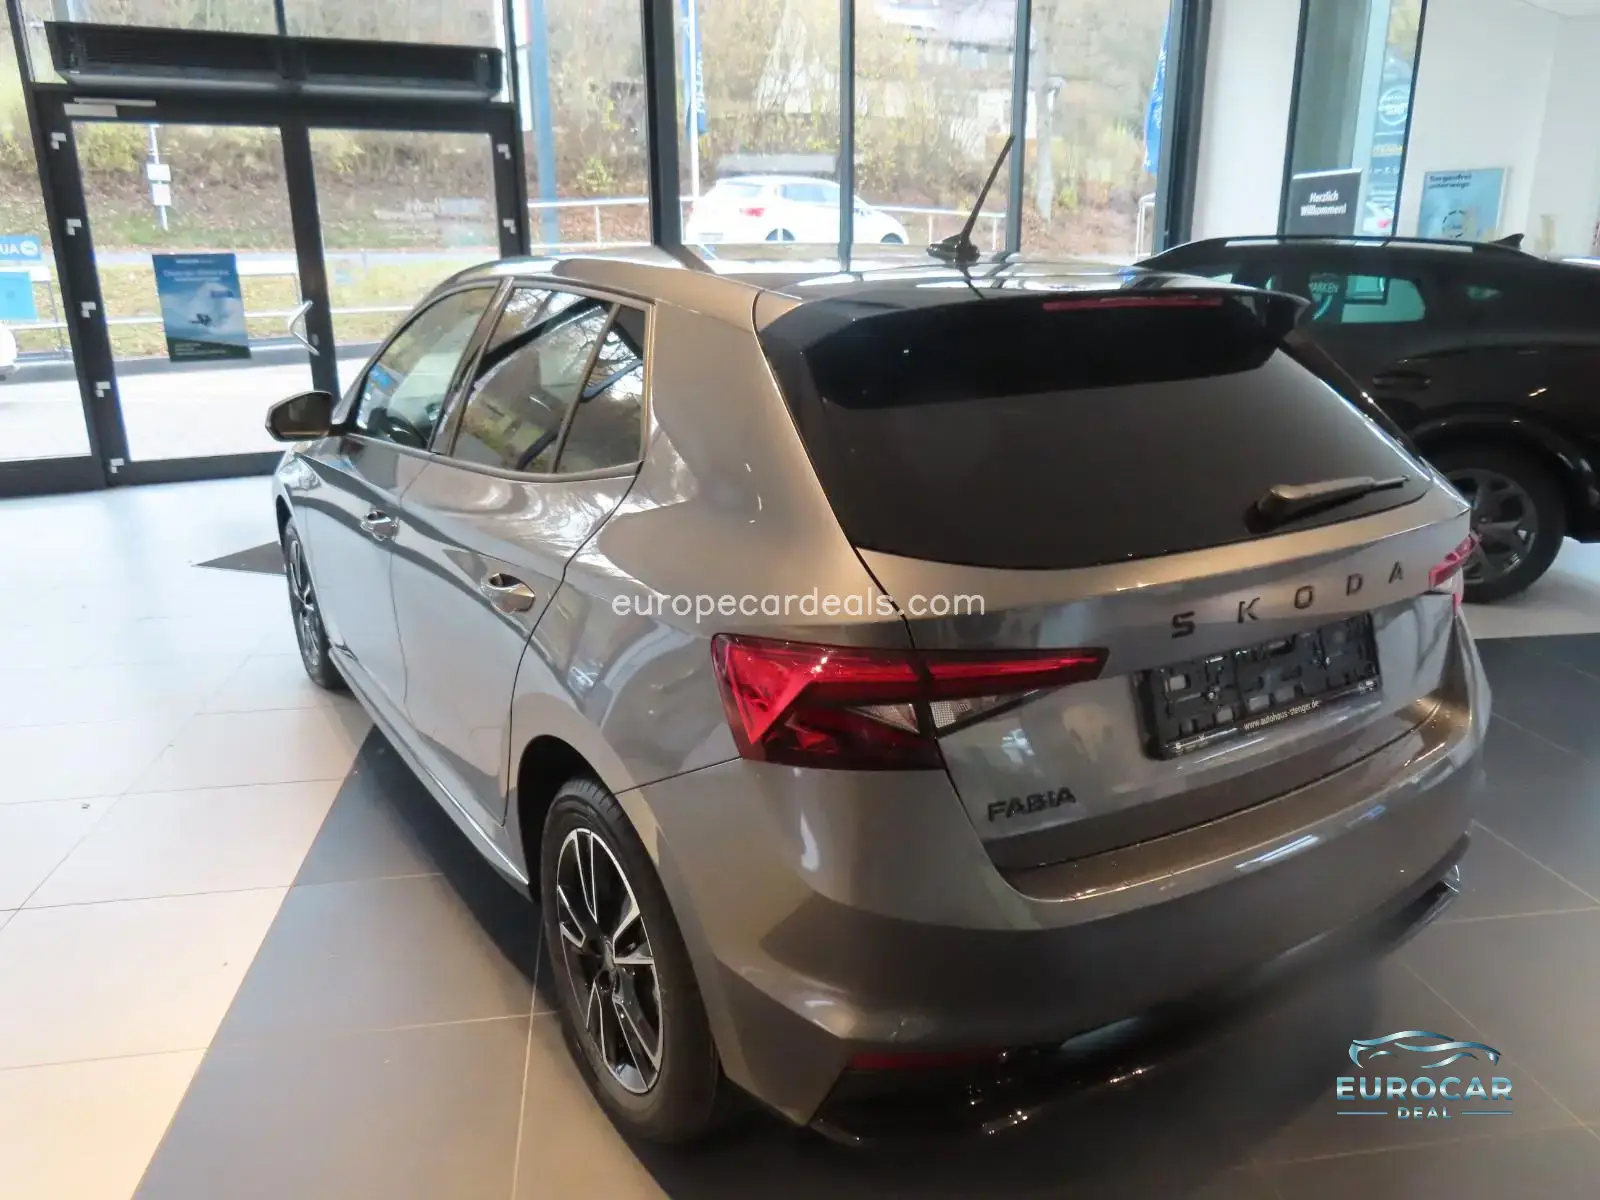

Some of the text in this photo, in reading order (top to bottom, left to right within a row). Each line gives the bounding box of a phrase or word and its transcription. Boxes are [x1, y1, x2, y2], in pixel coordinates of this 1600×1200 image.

[1309, 190, 1339, 203] Herzlich
[1300, 202, 1347, 217] Willkommen!
[1171, 561, 1404, 639] SKODA
[988, 786, 1077, 822] FABIA
